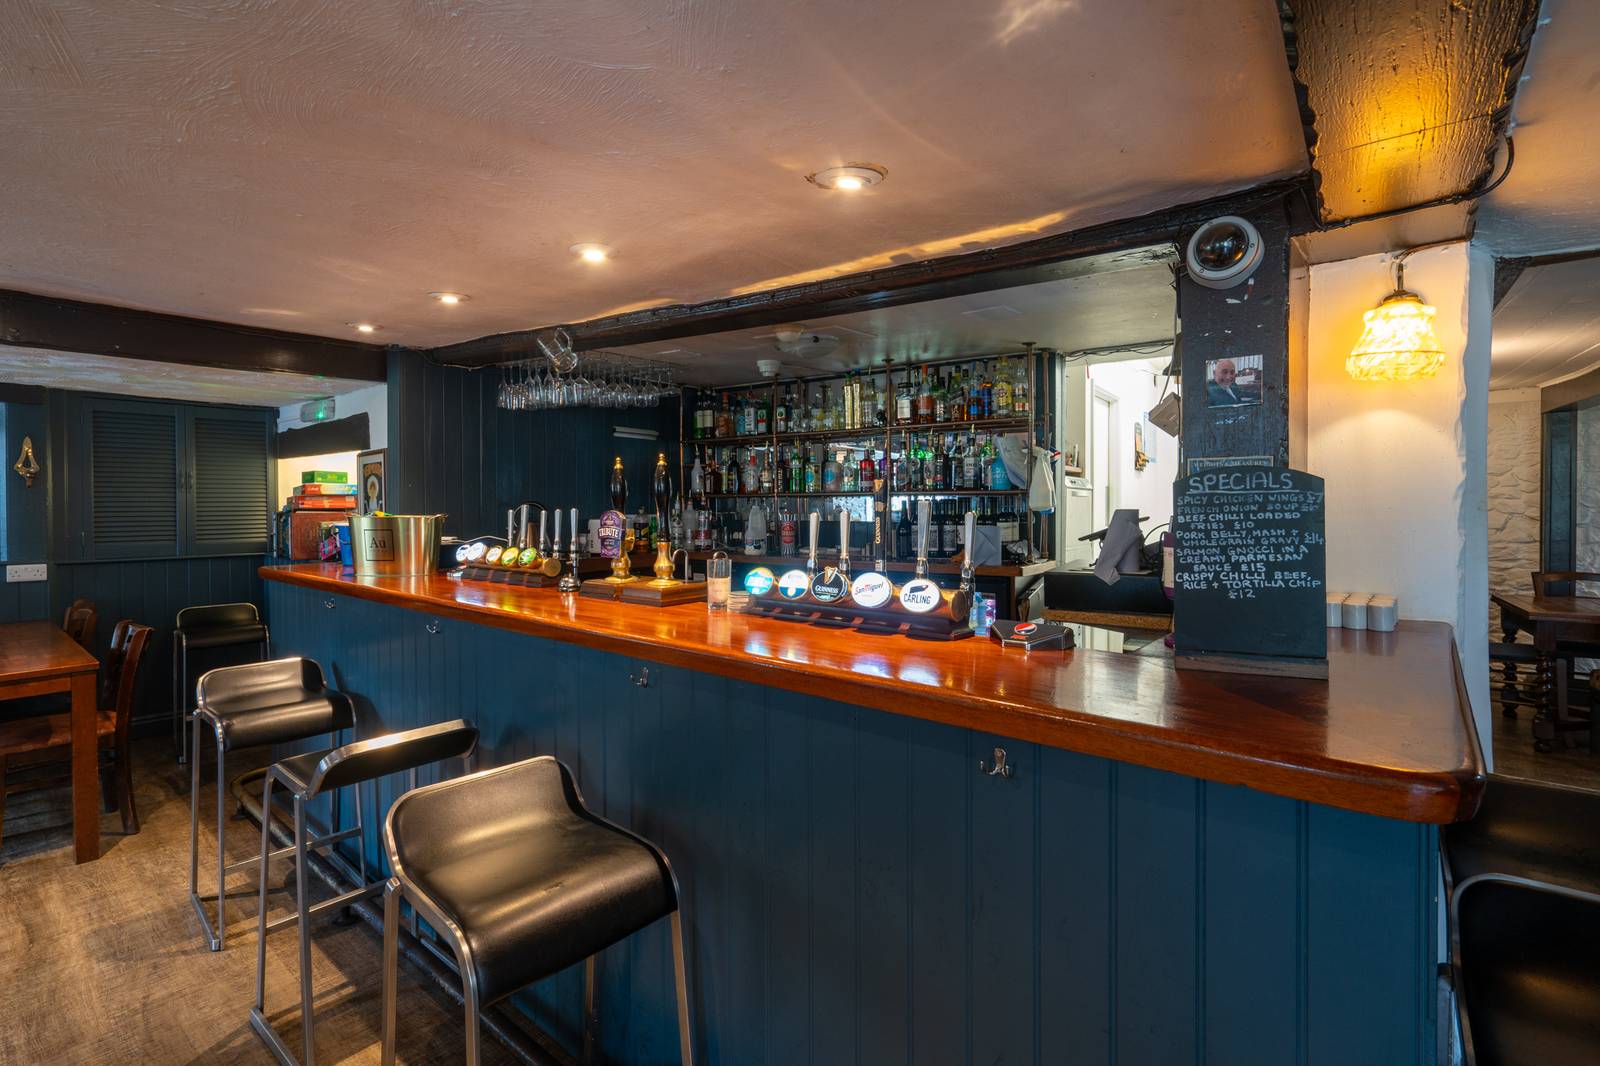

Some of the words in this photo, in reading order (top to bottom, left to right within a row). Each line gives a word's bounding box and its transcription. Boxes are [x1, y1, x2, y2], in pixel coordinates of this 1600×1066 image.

[1189, 472, 1293, 491] SPECIALS
[1177, 495, 1207, 505] SPICY
[1213, 493, 1263, 504] CHICKEN
[1268, 493, 1304, 502] WINGS
[1177, 506, 1219, 515] FRENCH
[1177, 514, 1207, 523] BEEF
[1208, 513, 1244, 521] CHILLI
[1250, 512, 1301, 520] LOADED
[1190, 521, 1224, 530] FRIES
[1234, 521, 1255, 529] £10
[598, 528, 619, 538] TRIBUTE
[1176, 530, 1205, 540] PORK
[1252, 529, 1286, 537] MASH
[1261, 535, 1299, 545] GRAVY
[1304, 532, 1325, 545] £14
[369, 537, 386, 548] Au
[1176, 547, 1220, 557] SALMON
[1227, 546, 1274, 556] GNOCCI
[1281, 545, 1295, 553] IN
[1300, 545, 1309, 553] A
[1179, 554, 1226, 564] CREAMY
[1231, 553, 1303, 563] PARMESAN
[1193, 563, 1232, 572] SAUCE
[1241, 562, 1267, 572] £15
[1175, 572, 1214, 582] CRISPY
[1219, 572, 1265, 580] CHILLI
[1183, 580, 1208, 590] RICE
[1223, 579, 1285, 589] TORTILLA
[903, 593, 931, 605] CARLING
[1229, 589, 1256, 599] £12
